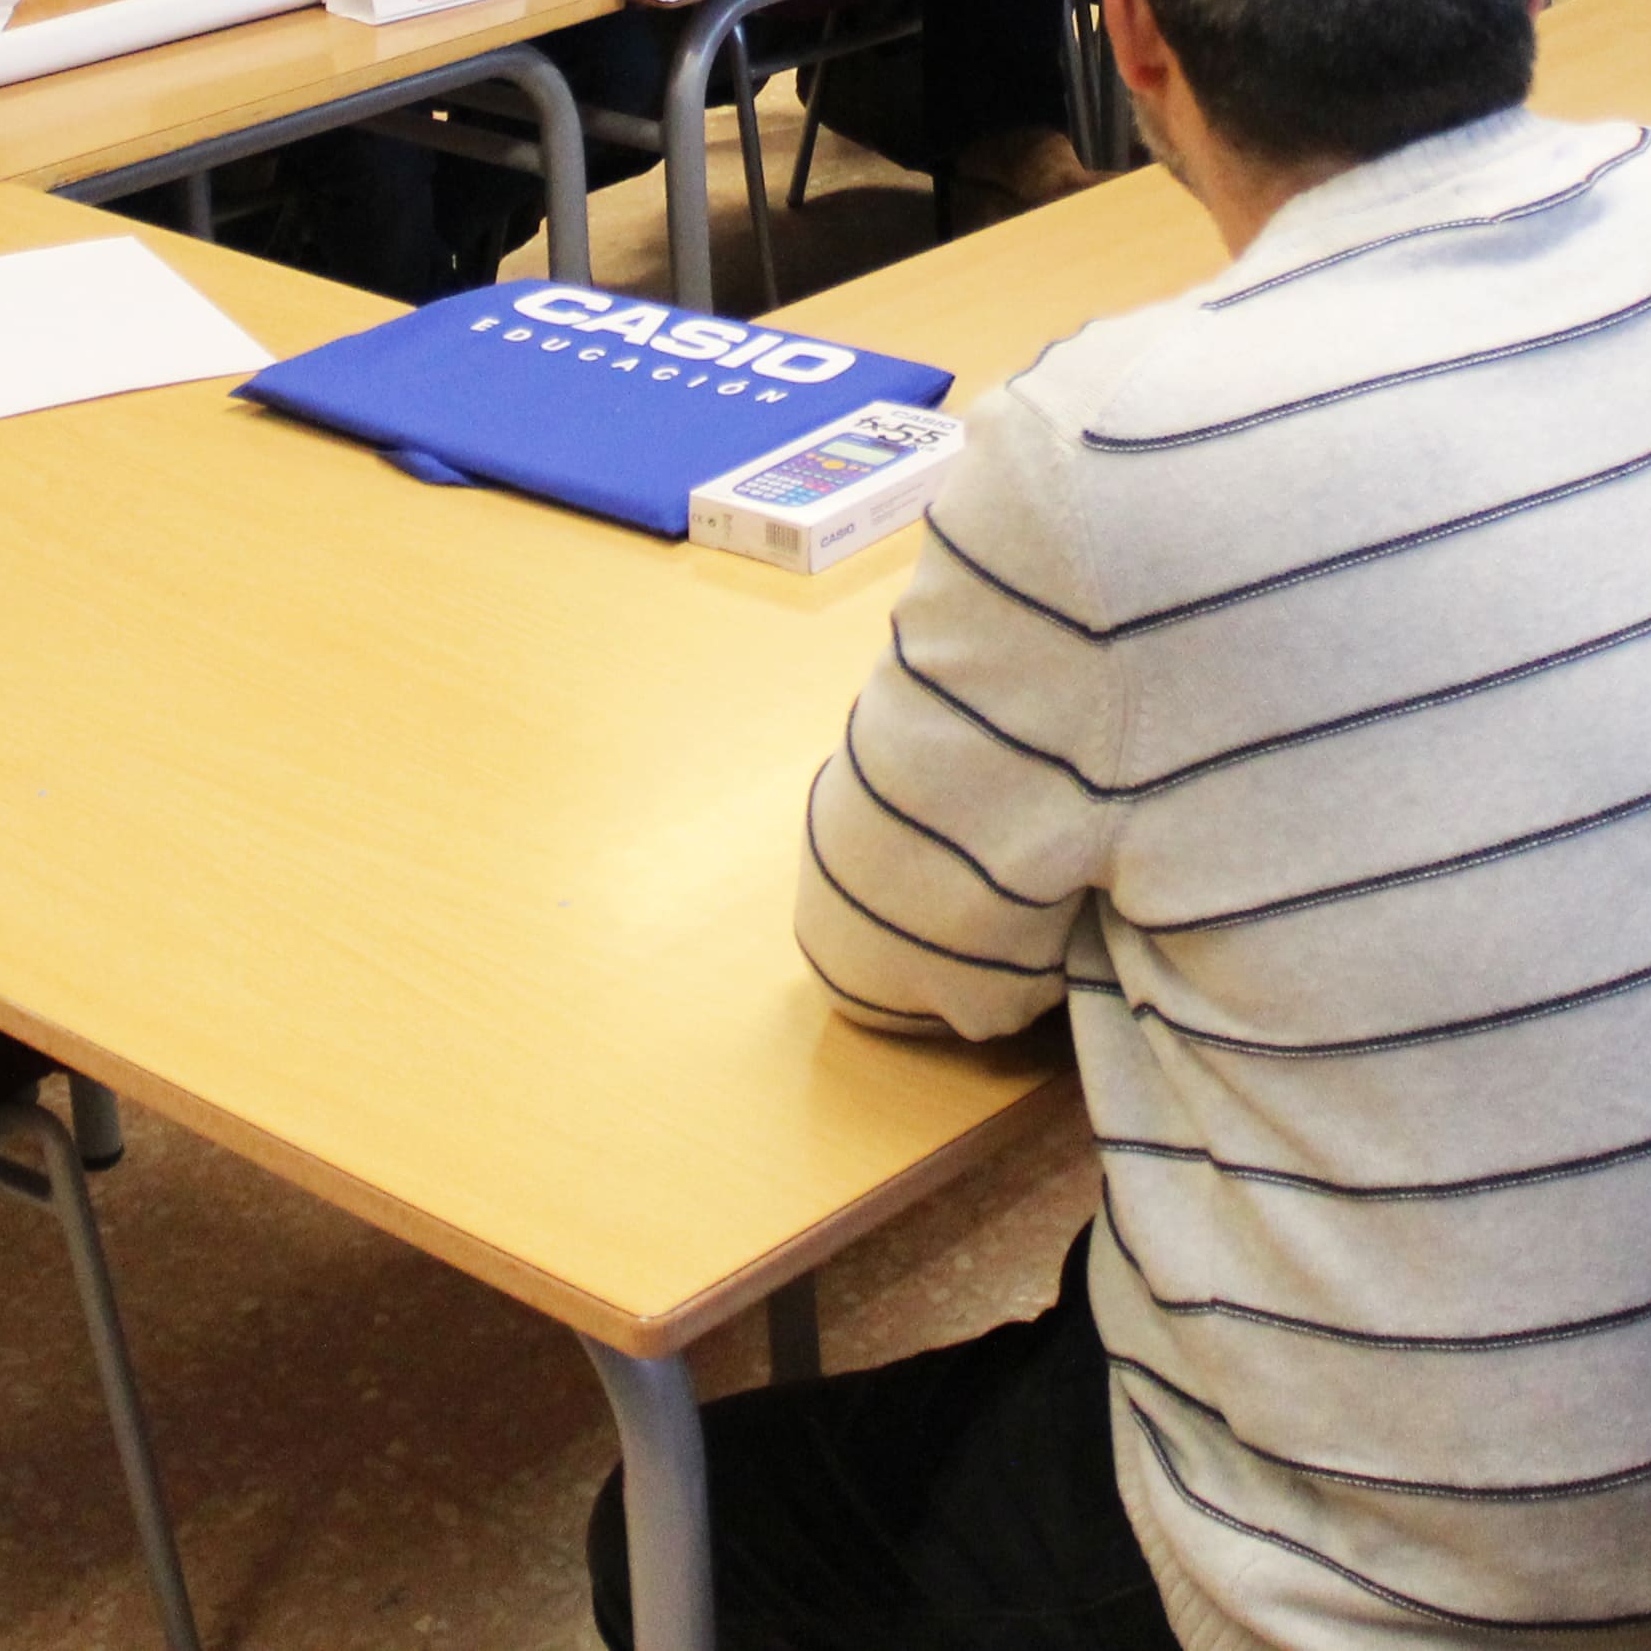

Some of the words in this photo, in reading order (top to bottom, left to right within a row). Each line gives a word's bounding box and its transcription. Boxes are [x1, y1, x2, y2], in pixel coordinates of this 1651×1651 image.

[469, 317, 788, 404] EDUCACIÓN
[513, 286, 858, 384] CASIO
[891, 410, 957, 430] CASIO
[820, 522, 856, 548] CASIO
